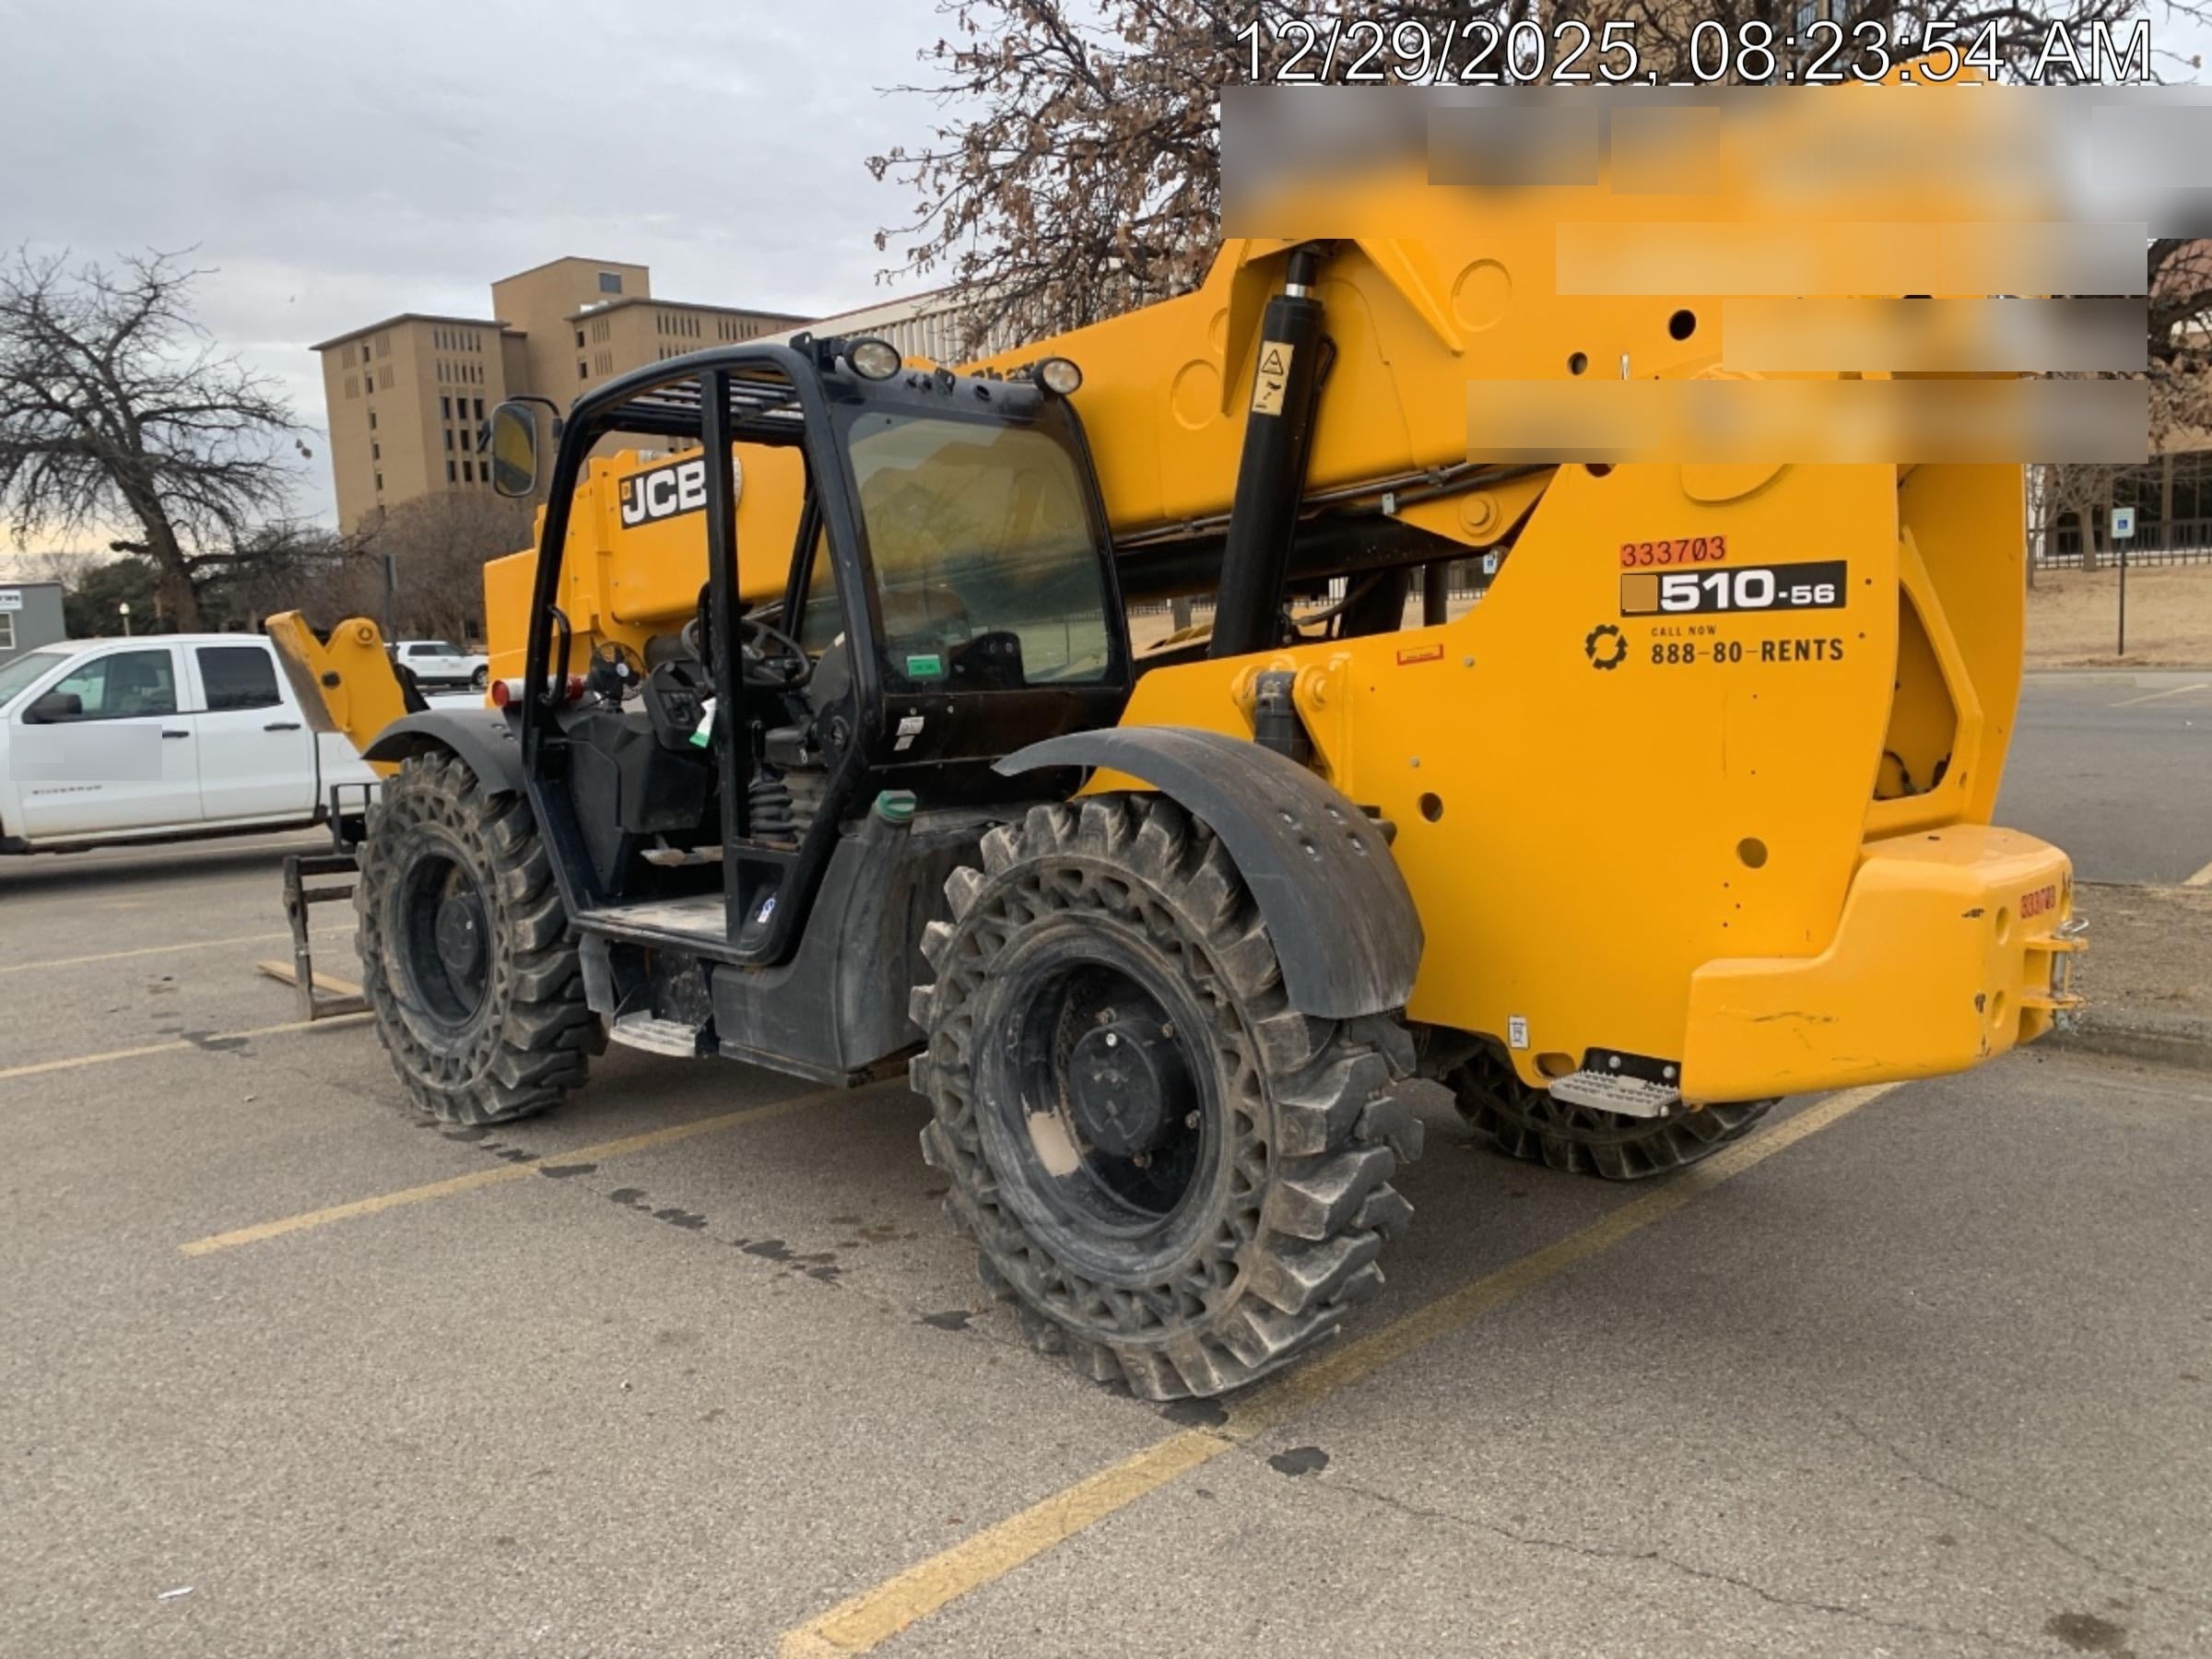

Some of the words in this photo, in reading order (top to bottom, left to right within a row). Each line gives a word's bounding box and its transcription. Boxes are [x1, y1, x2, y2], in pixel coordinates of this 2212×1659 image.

[622, 460, 707, 524] JCB
[1621, 535, 1726, 568] 333703
[1661, 570, 1835, 612] 510-56
[1651, 626, 1682, 637] CALL
[1688, 625, 1717, 635] NOW
[1651, 638, 1844, 665] 888-80-RENTS
